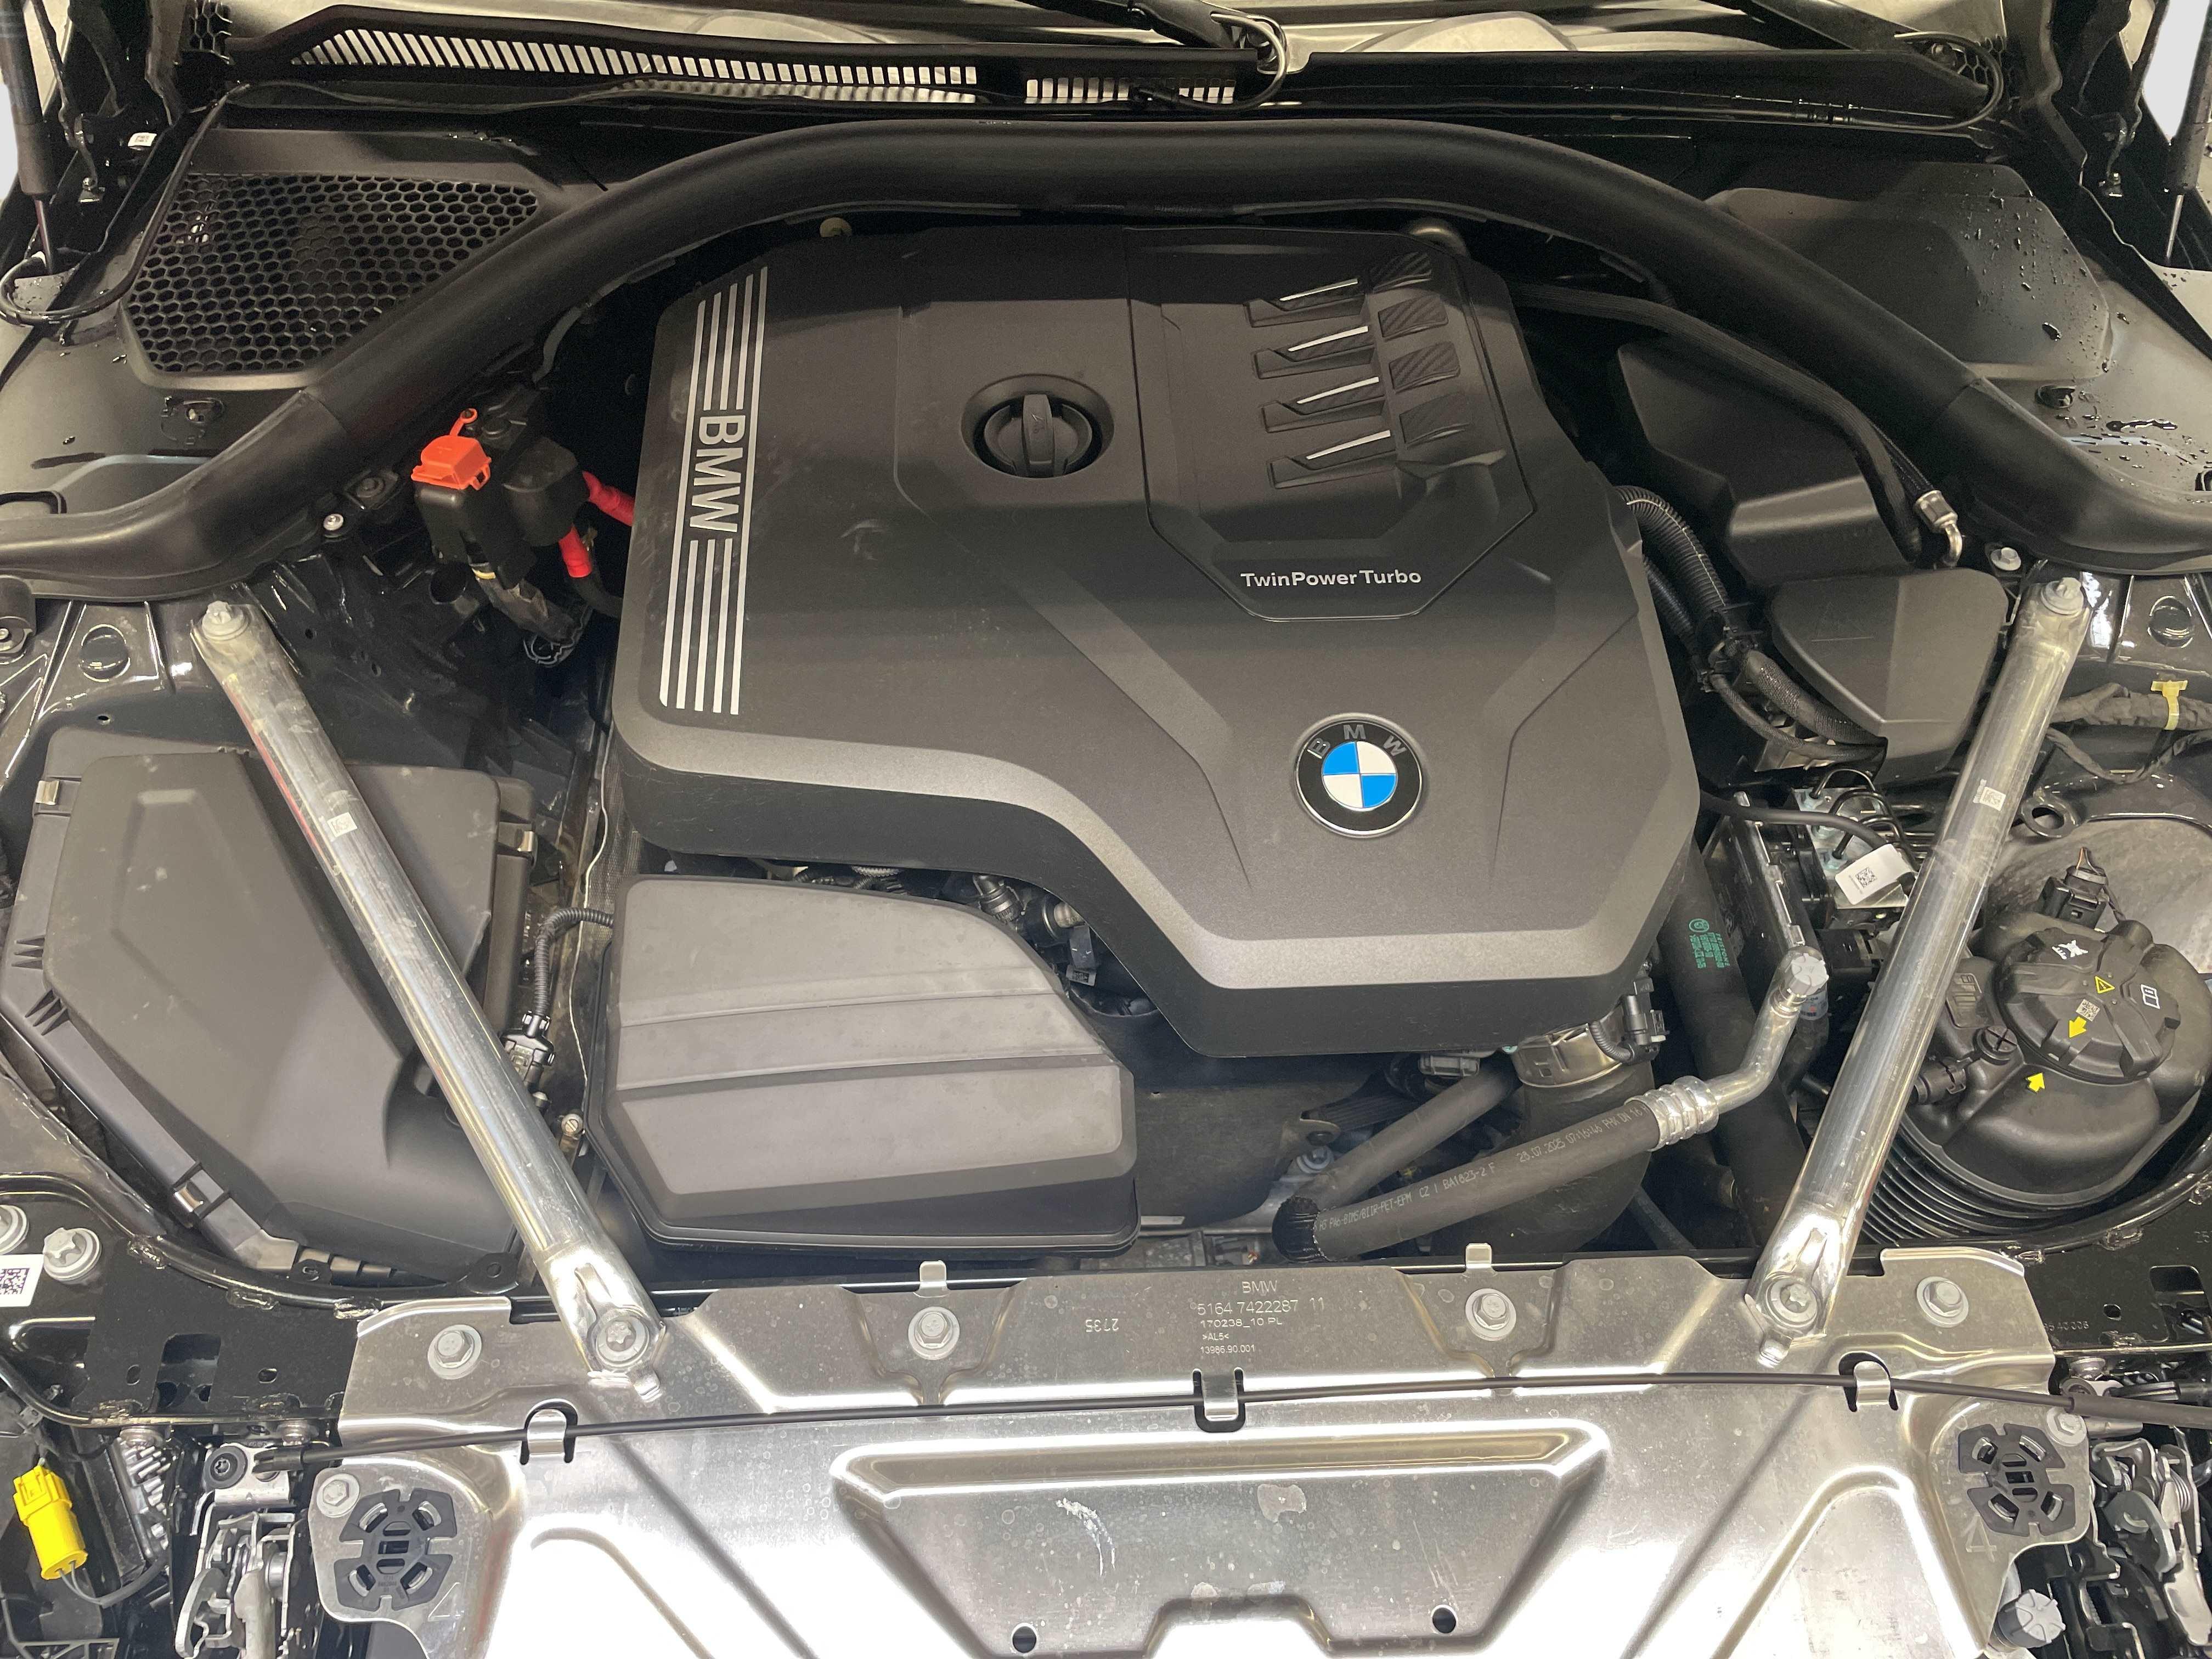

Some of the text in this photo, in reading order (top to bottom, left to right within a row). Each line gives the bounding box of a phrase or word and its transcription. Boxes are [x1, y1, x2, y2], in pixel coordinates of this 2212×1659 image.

[690, 415, 746, 533] BMW
[1359, 569, 1421, 584] Turbo
[1307, 724, 1407, 759] BMW
[1488, 1162, 1496, 1173] F
[1242, 1280, 1278, 1294] BMW
[1198, 1302, 1232, 1315] 5164
[1310, 1297, 1324, 1311] 11
